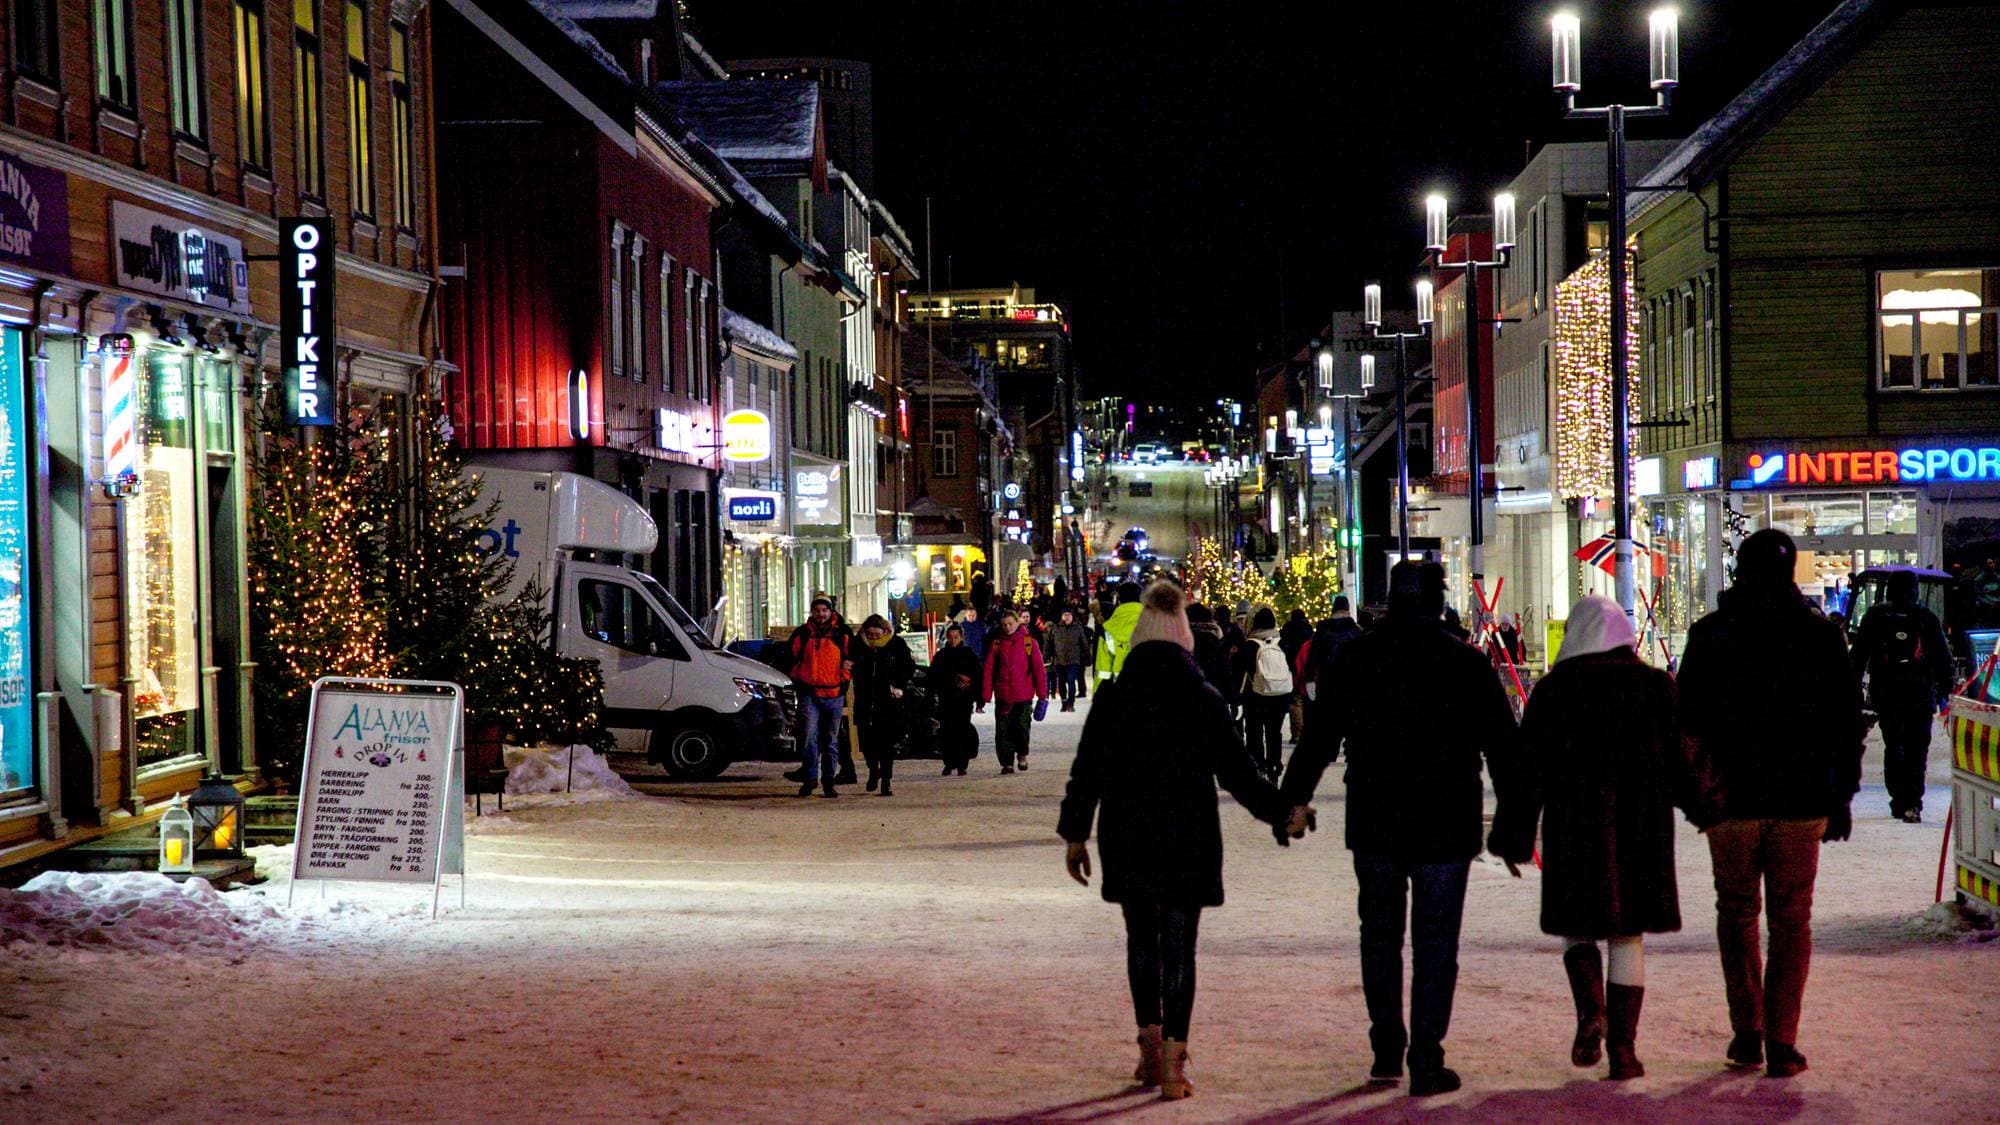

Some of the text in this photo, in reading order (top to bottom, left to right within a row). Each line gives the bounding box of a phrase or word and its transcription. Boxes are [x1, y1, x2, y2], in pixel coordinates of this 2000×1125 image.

[293, 224, 320, 418] OPTIKER
[733, 500, 771, 515] norli
[332, 703, 430, 741] ALANYA
[353, 742, 409, 764] DROP IN
[320, 770, 369, 778] HERREKLIPP
[320, 779, 366, 788] BARBERING
[400, 782, 412, 790] fra
[318, 788, 365, 796] DAMEKLIPP
[316, 806, 352, 814] FARGING
[358, 808, 394, 816] STRIPING
[315, 814, 349, 824] STYLING
[354, 816, 385, 825] FØNING
[314, 824, 336, 832] BRYN
[341, 825, 376, 834] FARGING
[340, 834, 398, 844] TRÅDFORMING
[312, 842, 340, 850] VIPPER
[345, 844, 381, 852] FARGING
[332, 852, 370, 860] PIERCING
[309, 860, 347, 868] HÅRVASK
[390, 864, 402, 872] fra
